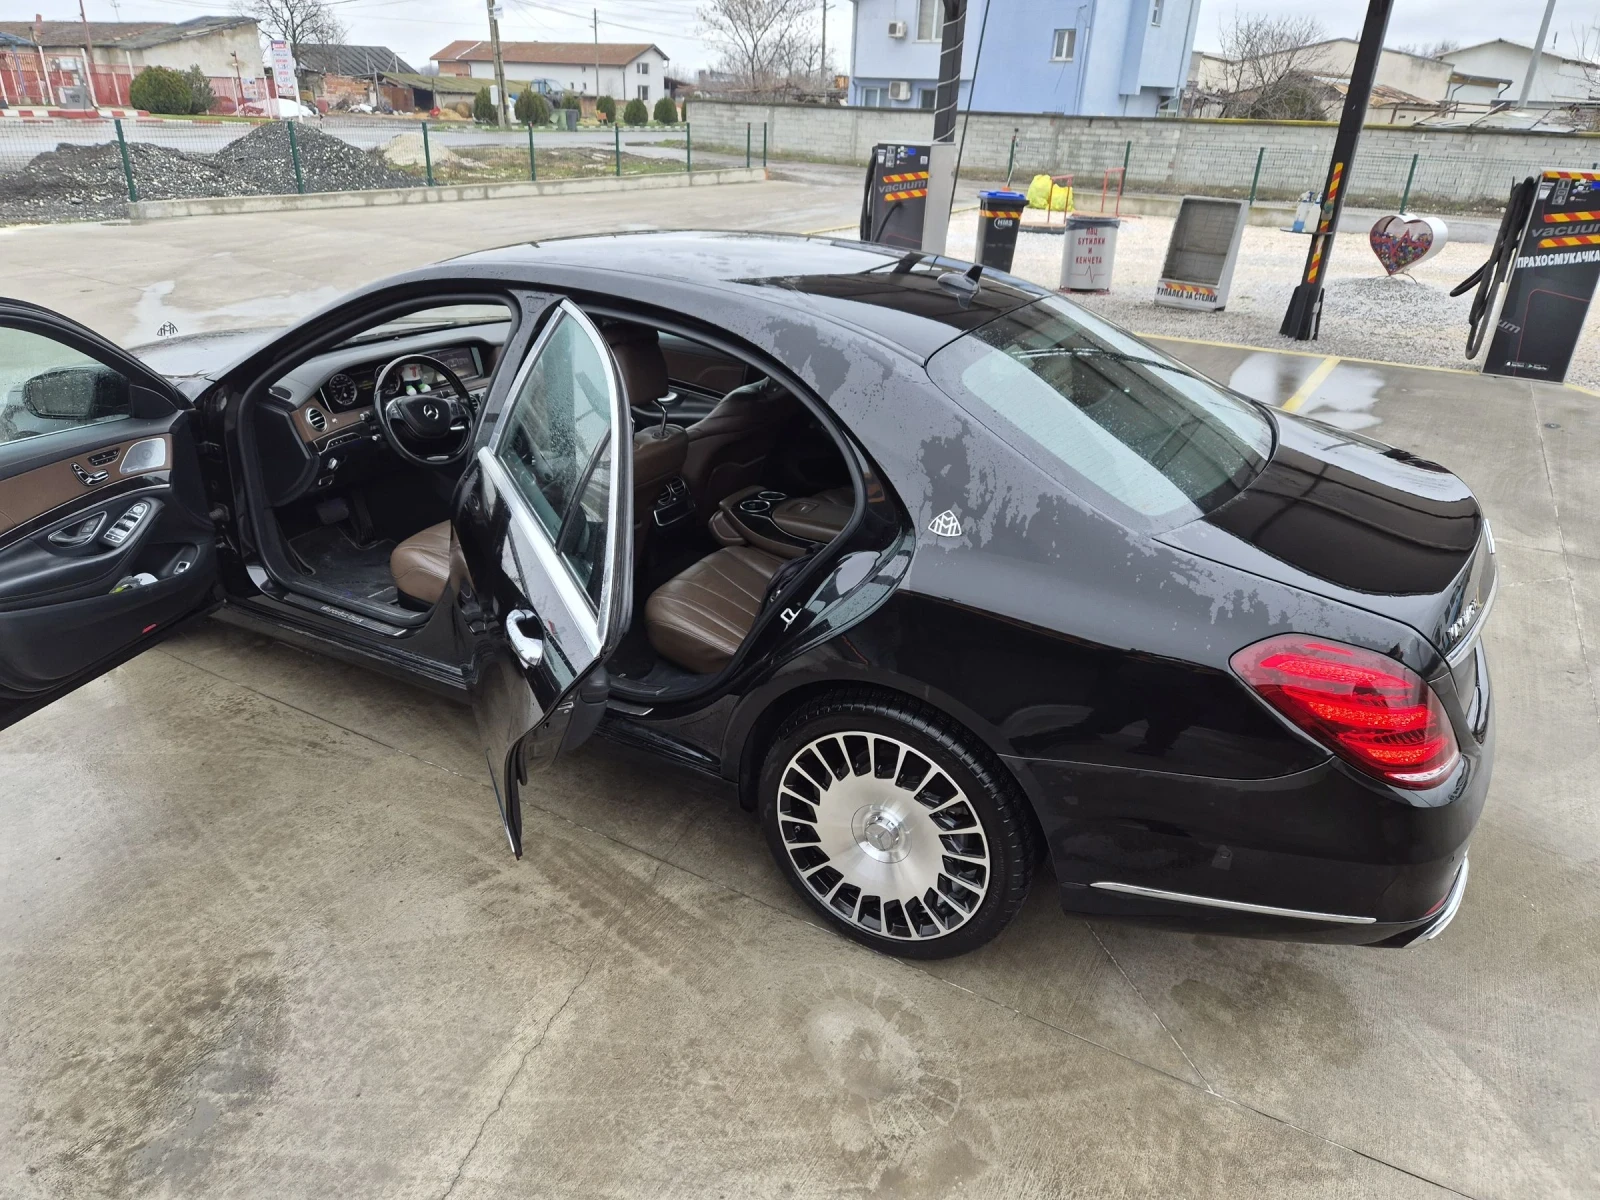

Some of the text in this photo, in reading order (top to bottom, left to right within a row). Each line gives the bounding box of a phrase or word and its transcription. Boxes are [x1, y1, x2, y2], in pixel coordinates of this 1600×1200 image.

[878, 180, 927, 193] vacuum
[997, 219, 1013, 227] HMS
[1077, 237, 1105, 245] БУТИЛКИ
[1075, 256, 1102, 264] КЕНЧЕТА
[1517, 250, 1600, 268] ПРАХОСМУКАЧКА
[1156, 287, 1218, 303] ТУПАЛКА ЗА СТЕЛКИ
